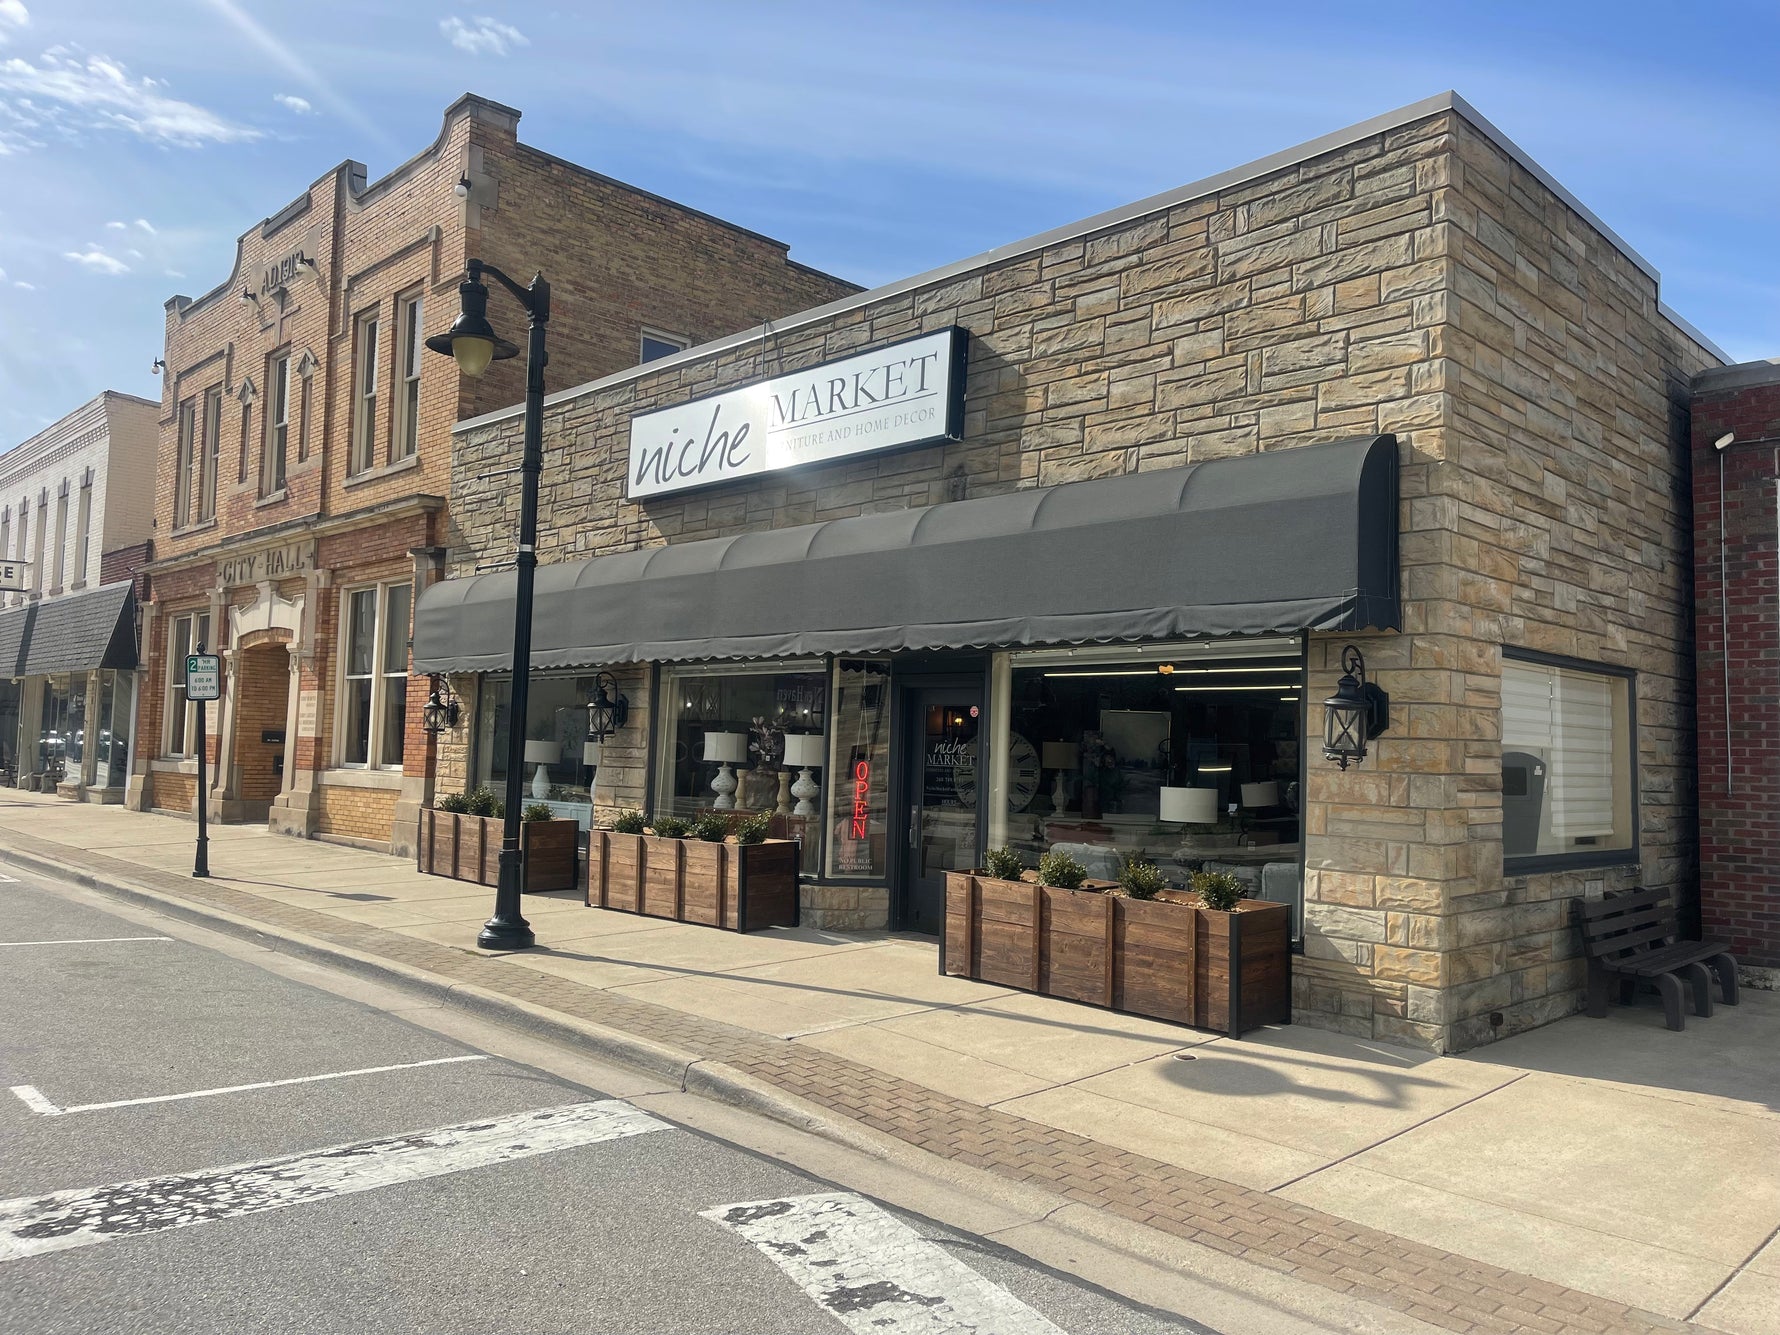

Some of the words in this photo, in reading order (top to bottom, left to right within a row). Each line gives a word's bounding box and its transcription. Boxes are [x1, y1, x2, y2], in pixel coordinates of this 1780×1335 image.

[769, 350, 938, 428] MARKET
[827, 427, 851, 443] AND
[855, 417, 890, 436] HOME
[894, 407, 936, 427] DECOR
[635, 403, 751, 486] niche
[223, 556, 257, 583] CITY
[266, 545, 305, 576] HALL
[190, 660, 196, 671] 2
[927, 753, 975, 766] MARKET
[934, 737, 967, 755] niche
[852, 761, 869, 839] OPEN
